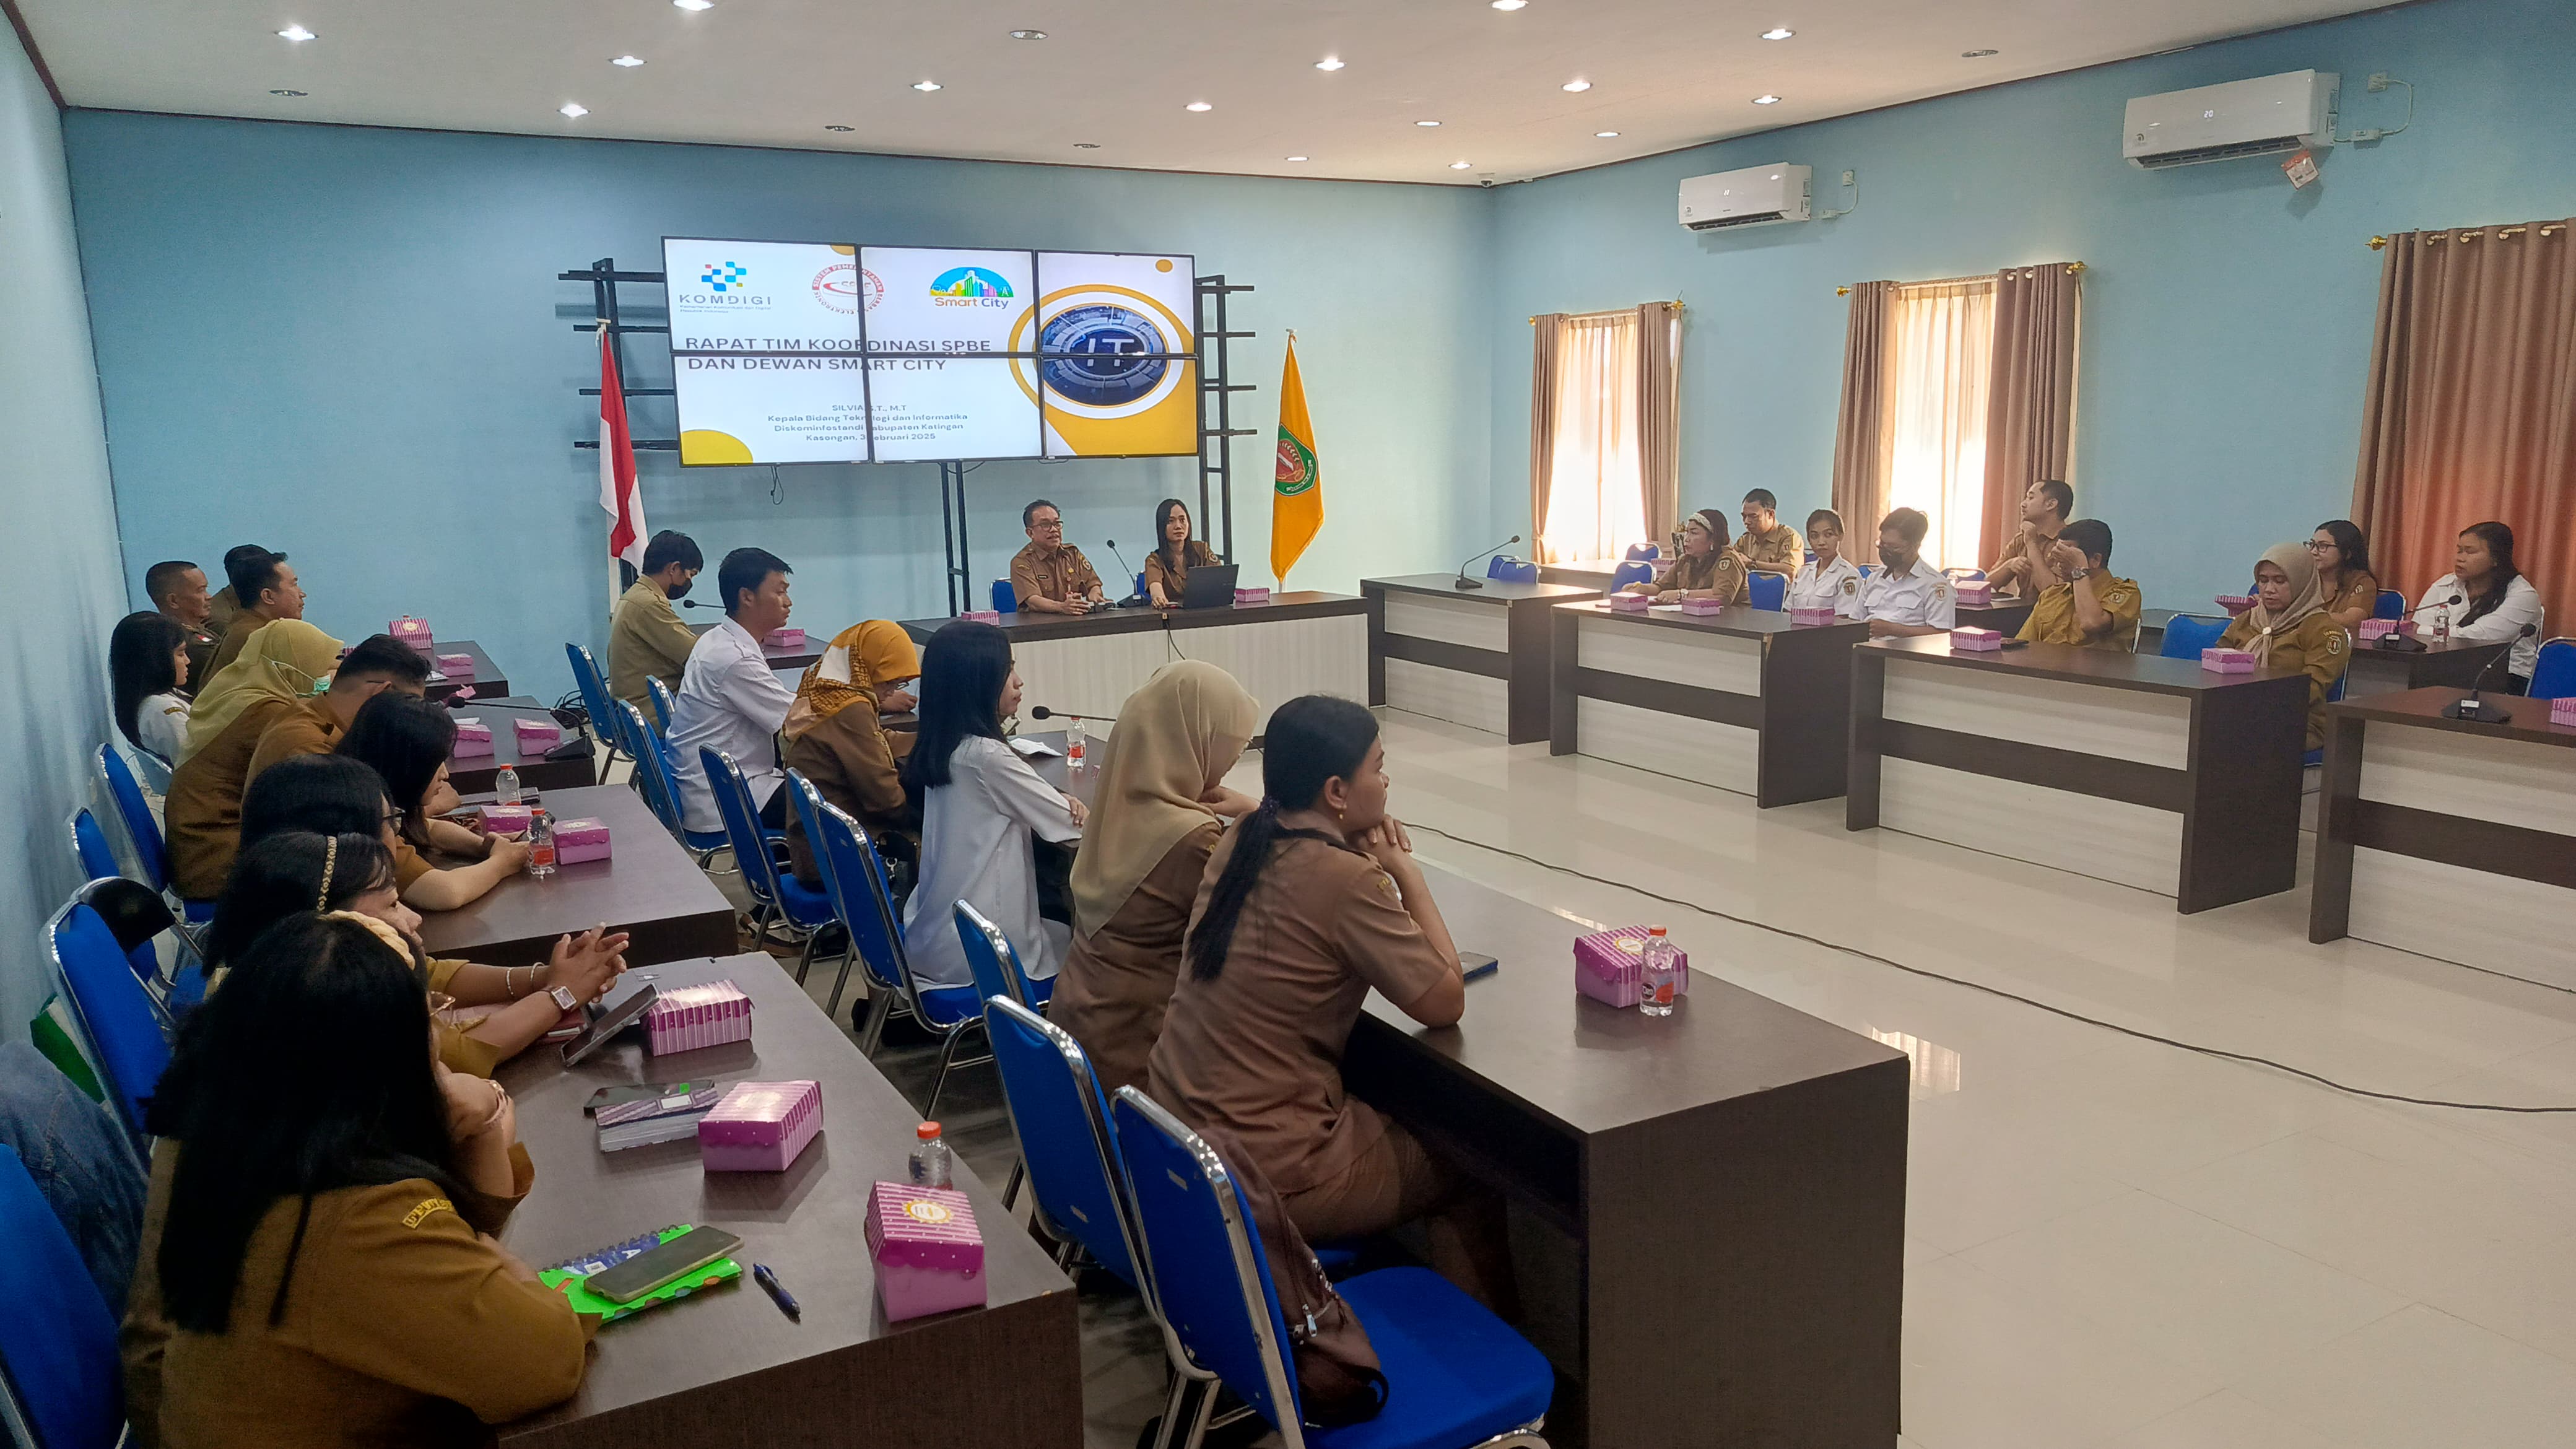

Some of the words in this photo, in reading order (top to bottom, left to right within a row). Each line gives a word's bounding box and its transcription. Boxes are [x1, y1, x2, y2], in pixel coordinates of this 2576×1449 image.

[2204, 110, 2214, 118] 20
[679, 294, 771, 305] KOMDIGI
[935, 297, 978, 307] Smart
[981, 298, 1009, 310] City
[685, 337, 757, 349] RAPAT
[763, 339, 801, 350] TIM
[941, 341, 991, 351] SPBE
[1087, 338, 1134, 367] IT
[688, 359, 736, 370] DAN
[743, 359, 821, 370] DEWAN
[903, 360, 946, 370] CITY
[843, 414, 890, 422] Teklogi
[868, 424, 919, 432] abupaten
